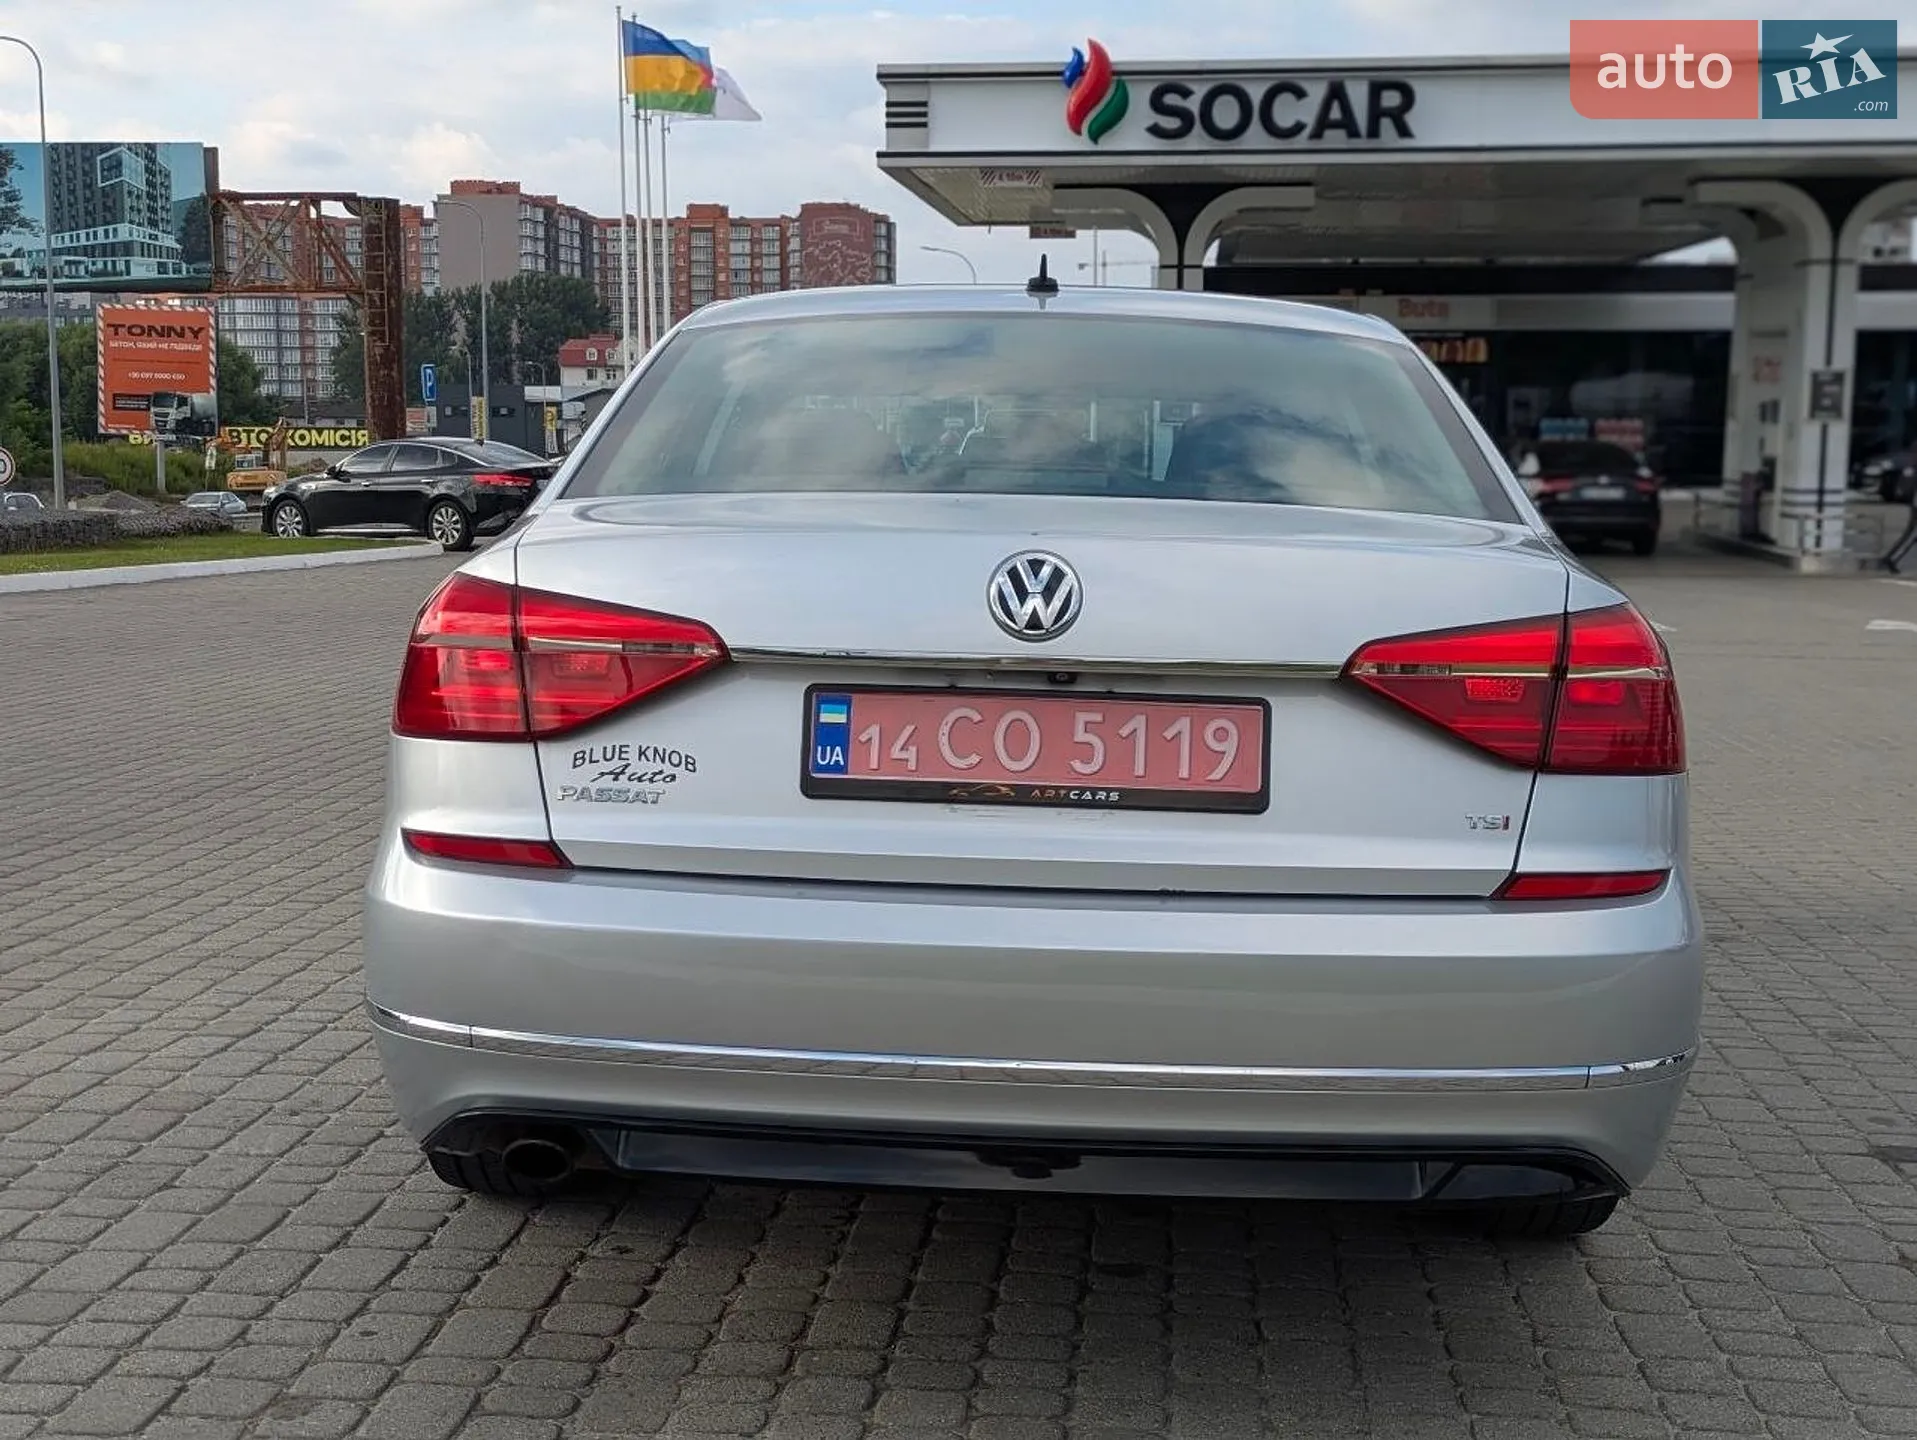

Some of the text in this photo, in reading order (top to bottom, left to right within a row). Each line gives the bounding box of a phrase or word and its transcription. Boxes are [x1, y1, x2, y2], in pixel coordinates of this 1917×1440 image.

[1145, 79, 1417, 141] SOCAR
[106, 323, 205, 340] TONNY
[425, 367, 433, 398] P
[858, 706, 1240, 782] 14 CO 5119
[572, 744, 697, 773] BLUE KNOB
[817, 745, 845, 767] UA
[590, 762, 677, 784] Auto
[557, 785, 666, 804] PASSAT
[1464, 814, 1511, 831] TSI
